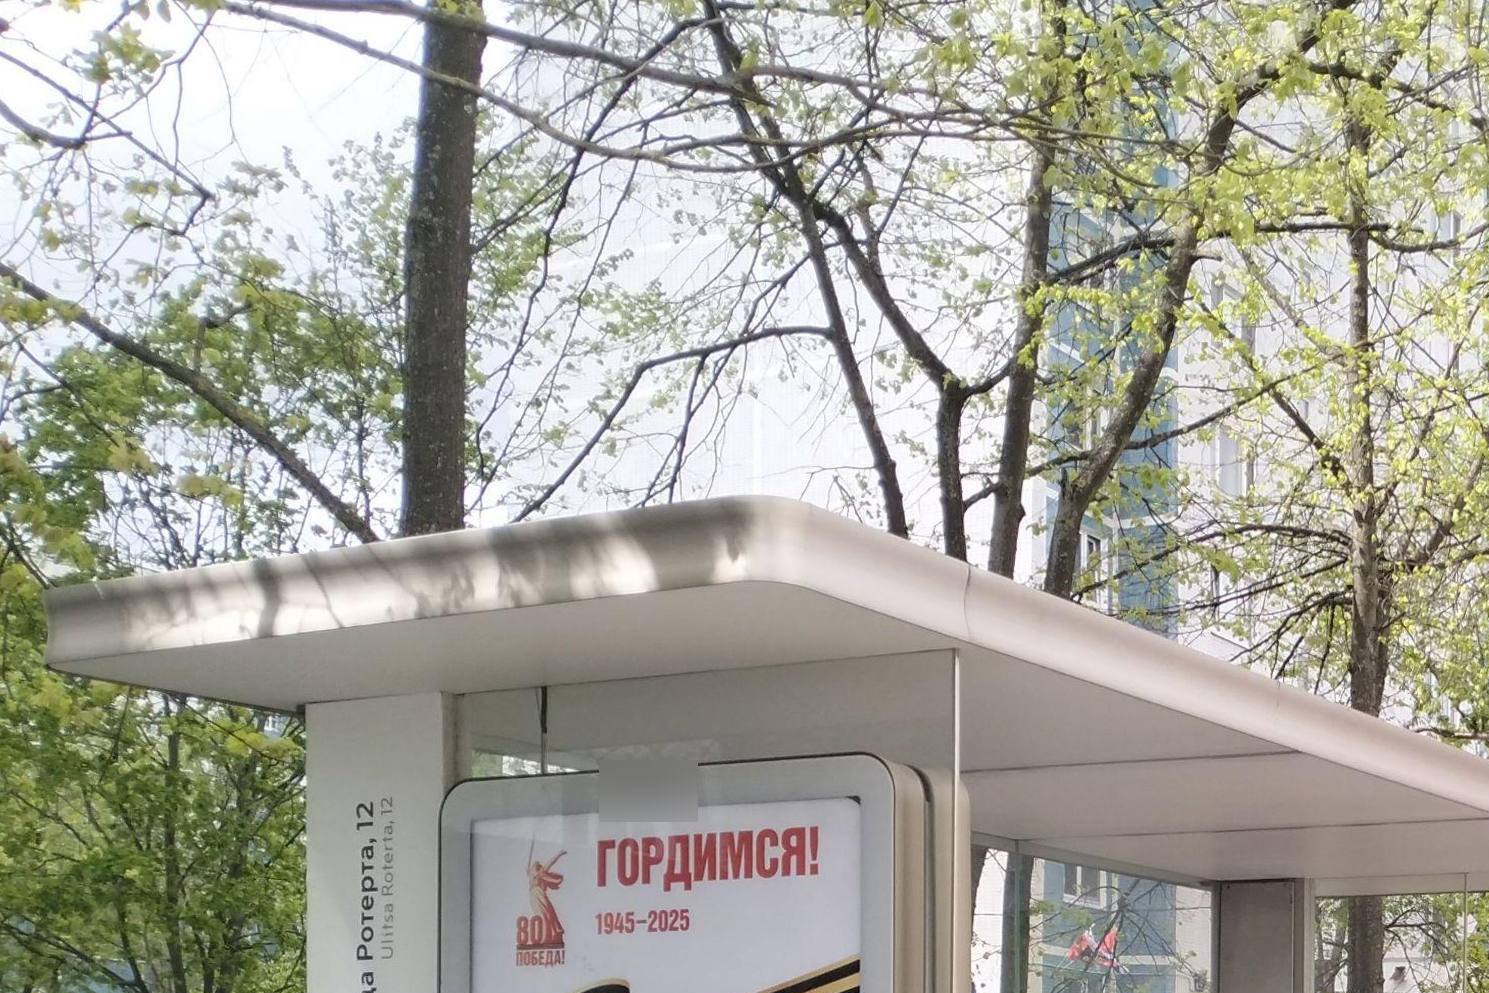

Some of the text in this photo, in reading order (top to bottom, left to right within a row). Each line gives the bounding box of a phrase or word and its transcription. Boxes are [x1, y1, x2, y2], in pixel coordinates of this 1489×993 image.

[356, 801, 374, 830] 12
[596, 826, 820, 892] ГОРДИМСЯ!
[381, 796, 396, 960] Ulitsa Roterta, 12
[356, 837, 379, 961] Ротерта,
[516, 915, 544, 945] 80
[595, 909, 690, 935] 1945-2025
[516, 950, 565, 968] ПОБЕДА!
